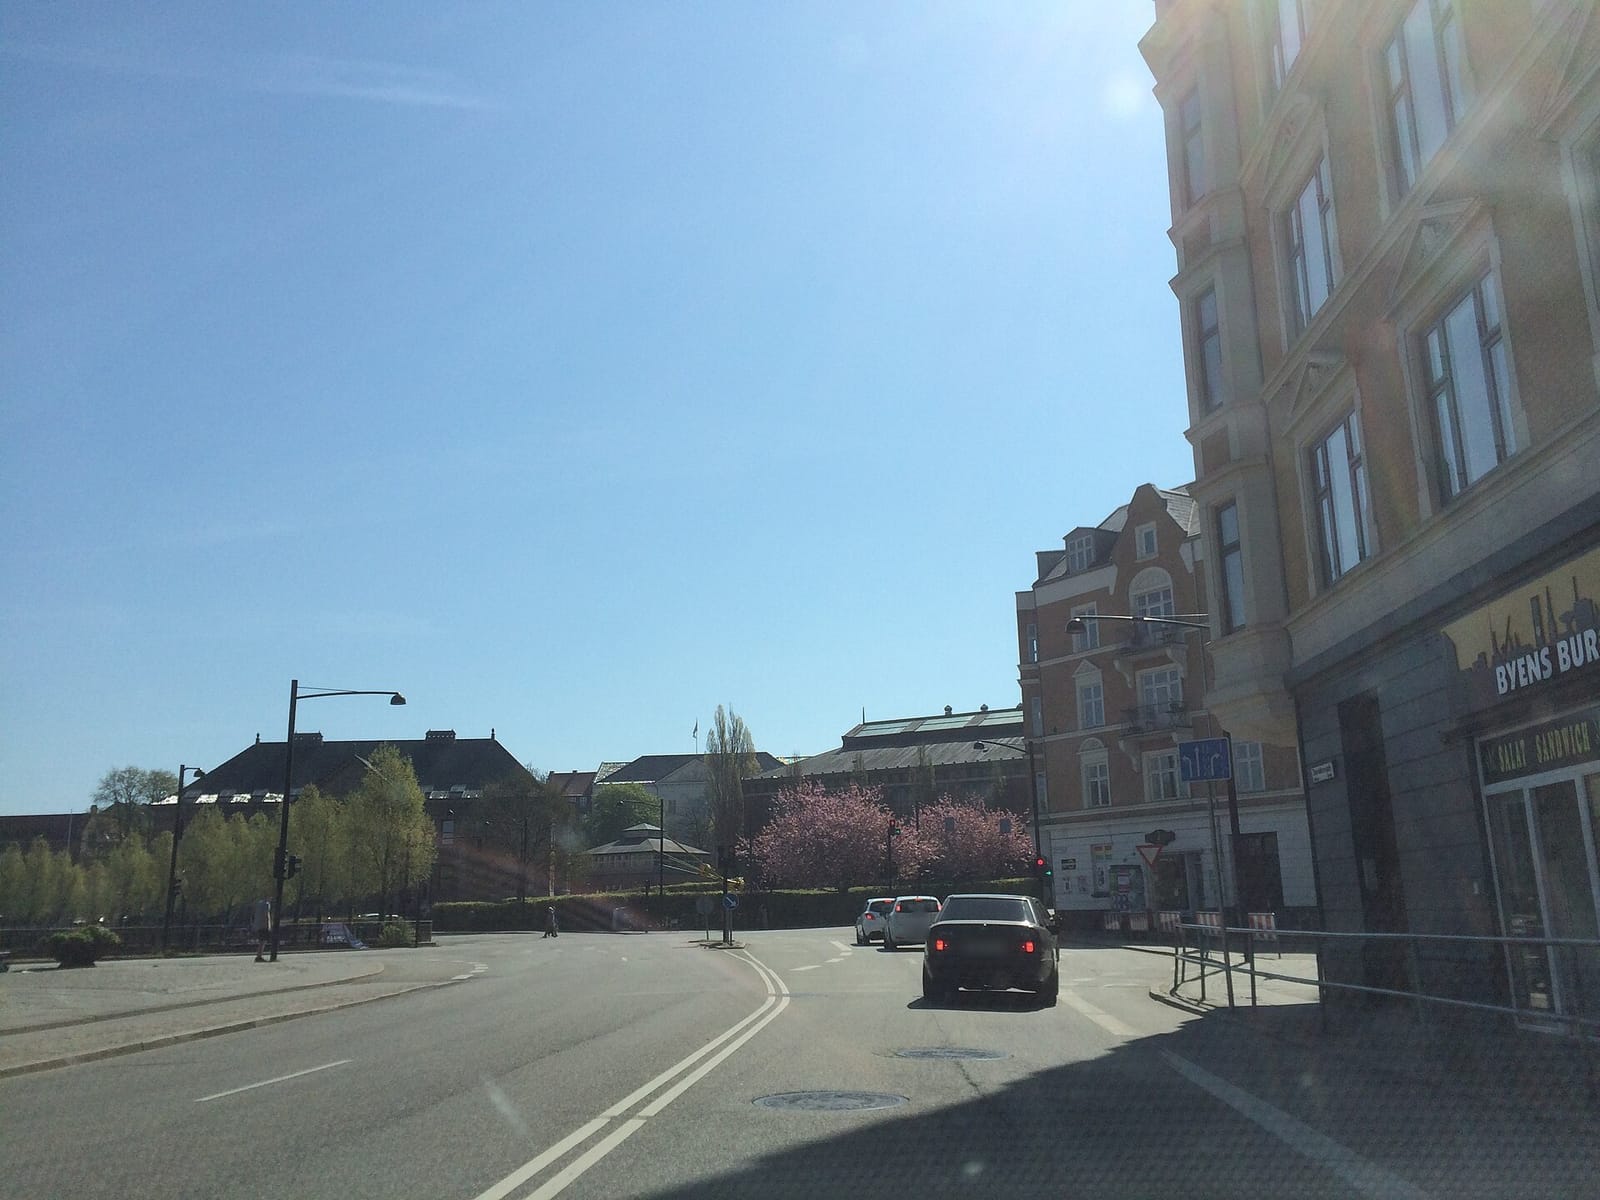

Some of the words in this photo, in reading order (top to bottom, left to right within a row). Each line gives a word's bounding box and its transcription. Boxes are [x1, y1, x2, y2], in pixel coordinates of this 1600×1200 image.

[1495, 646, 1553, 695] BYENS
[1498, 738, 1528, 773] SALAT
[1535, 720, 1591, 764] SANDWICH
